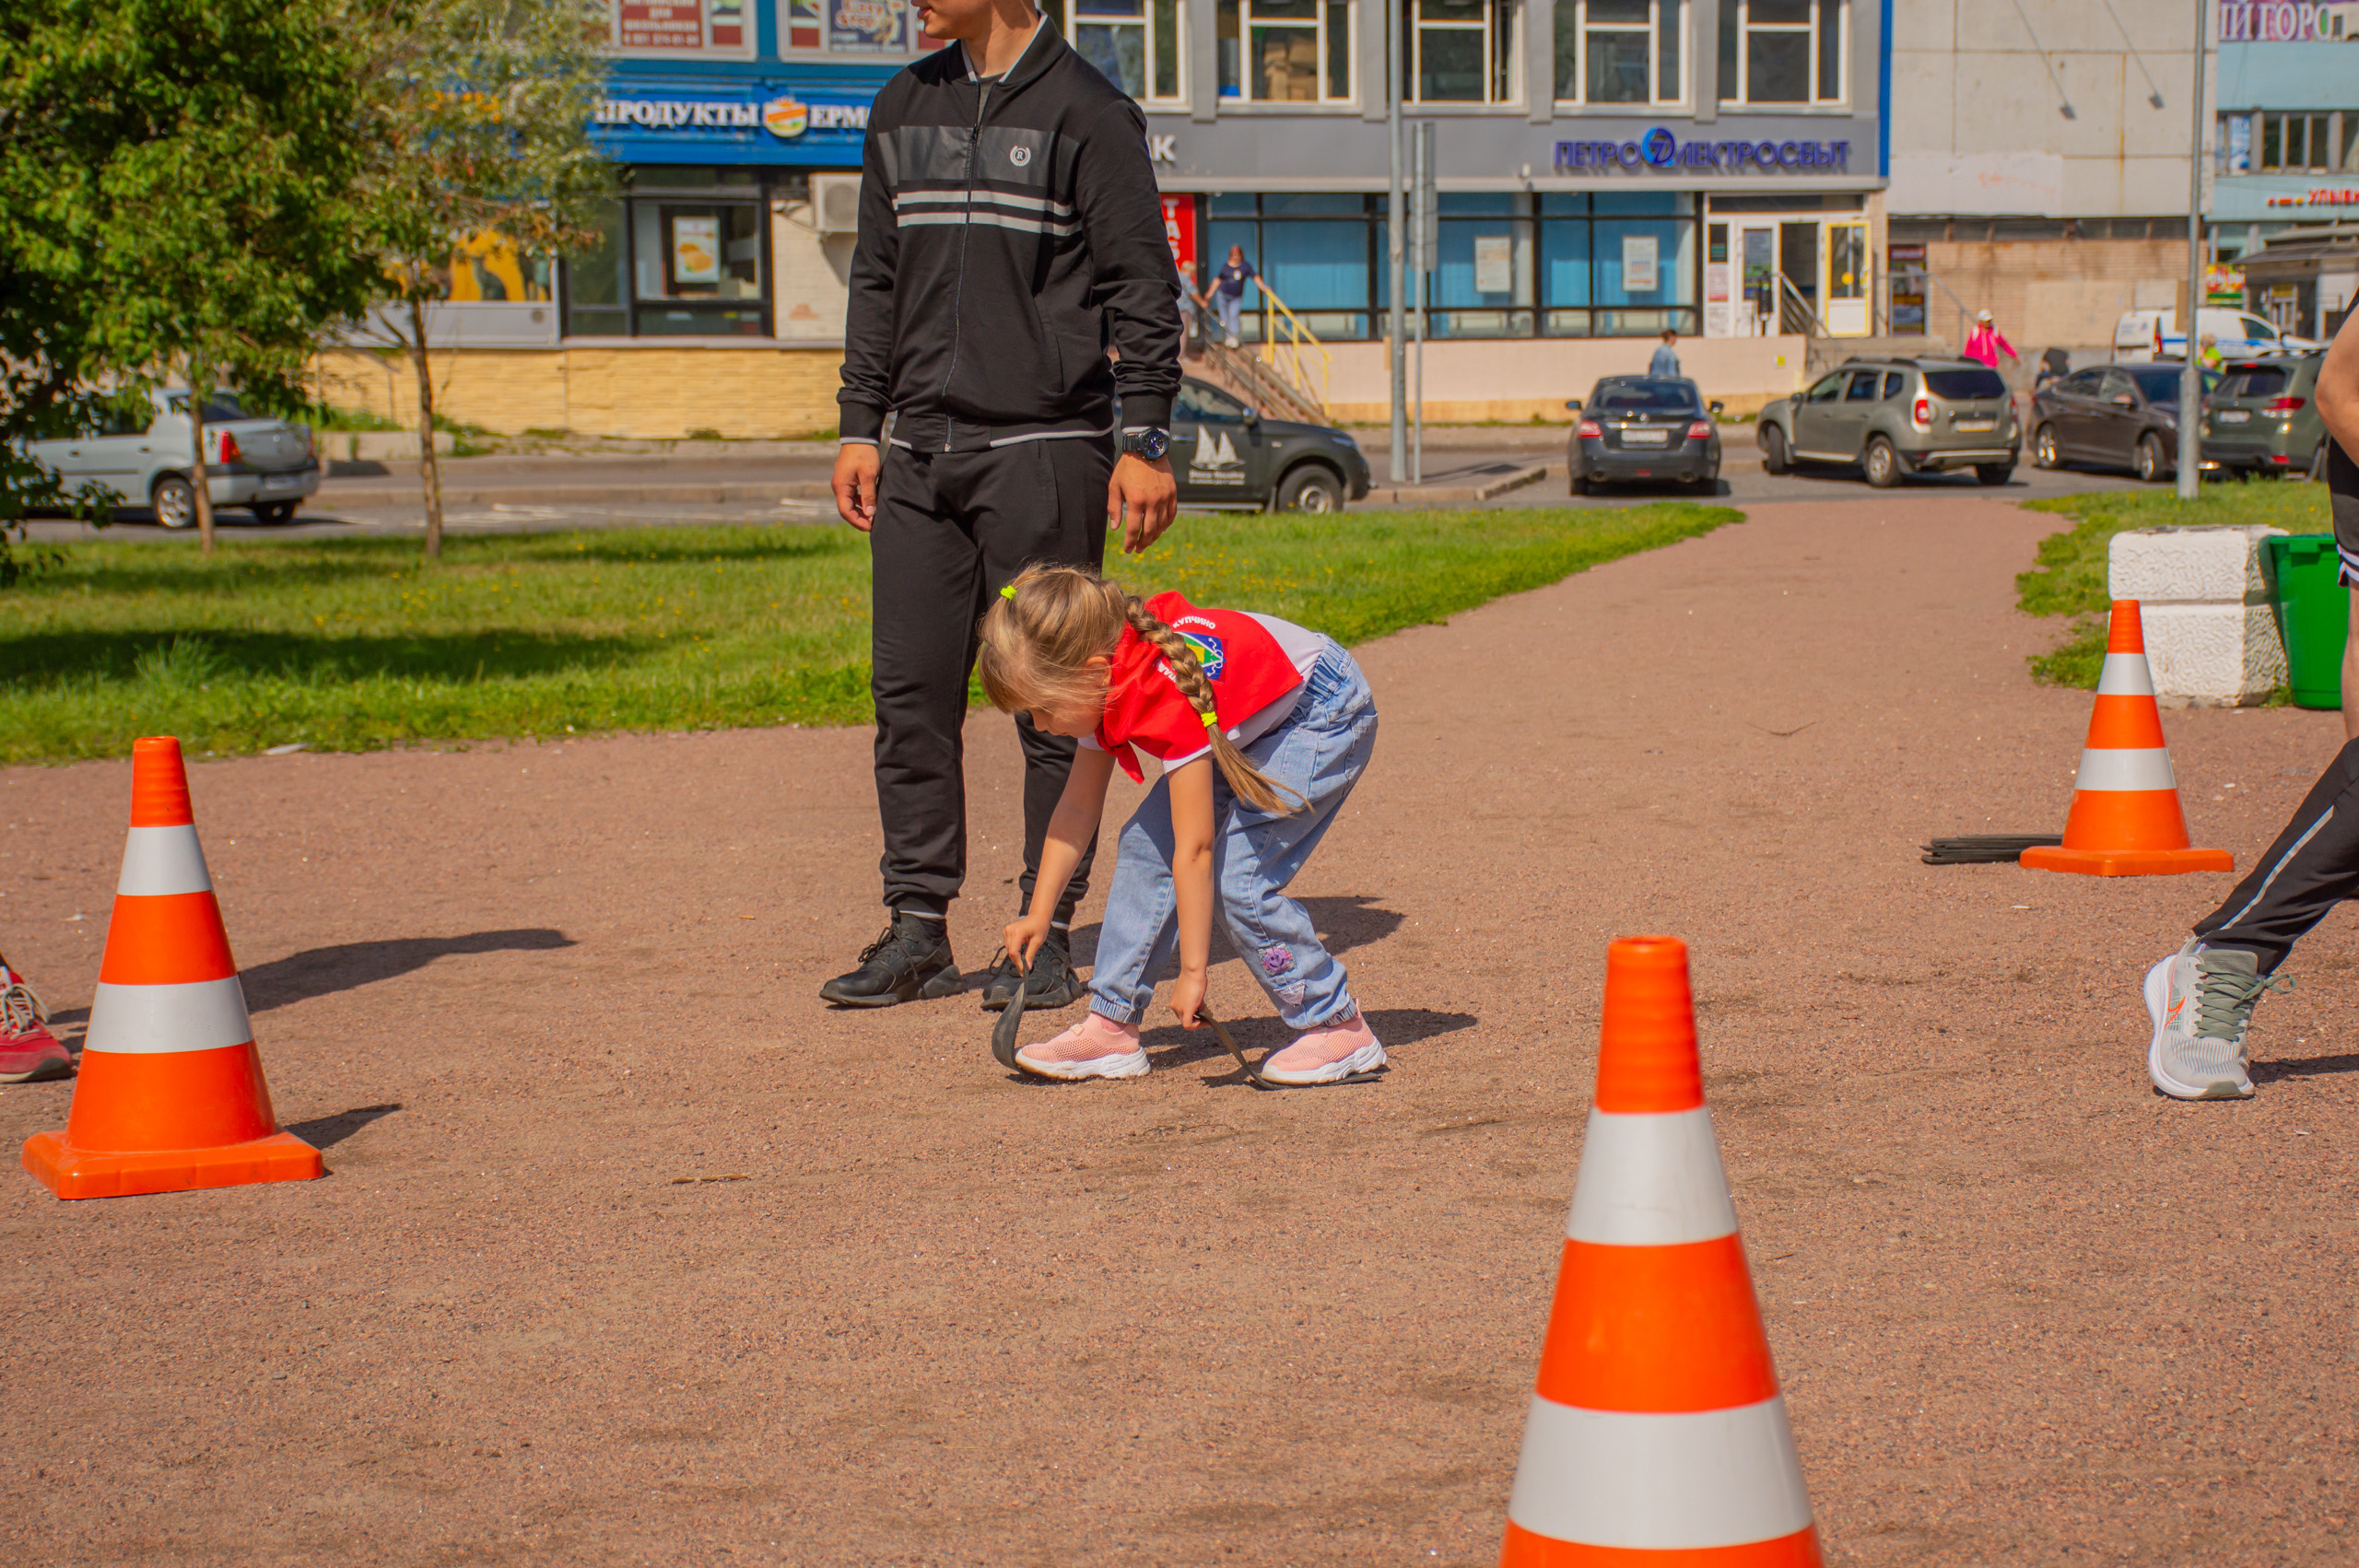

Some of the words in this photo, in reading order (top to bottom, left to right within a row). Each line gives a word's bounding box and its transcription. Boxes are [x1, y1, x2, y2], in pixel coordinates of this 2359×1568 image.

[595, 99, 759, 128] ПРОДУКТЫ
[809, 104, 871, 129] ЕРМ
[1172, 615, 1216, 630] КУПЧИНО
